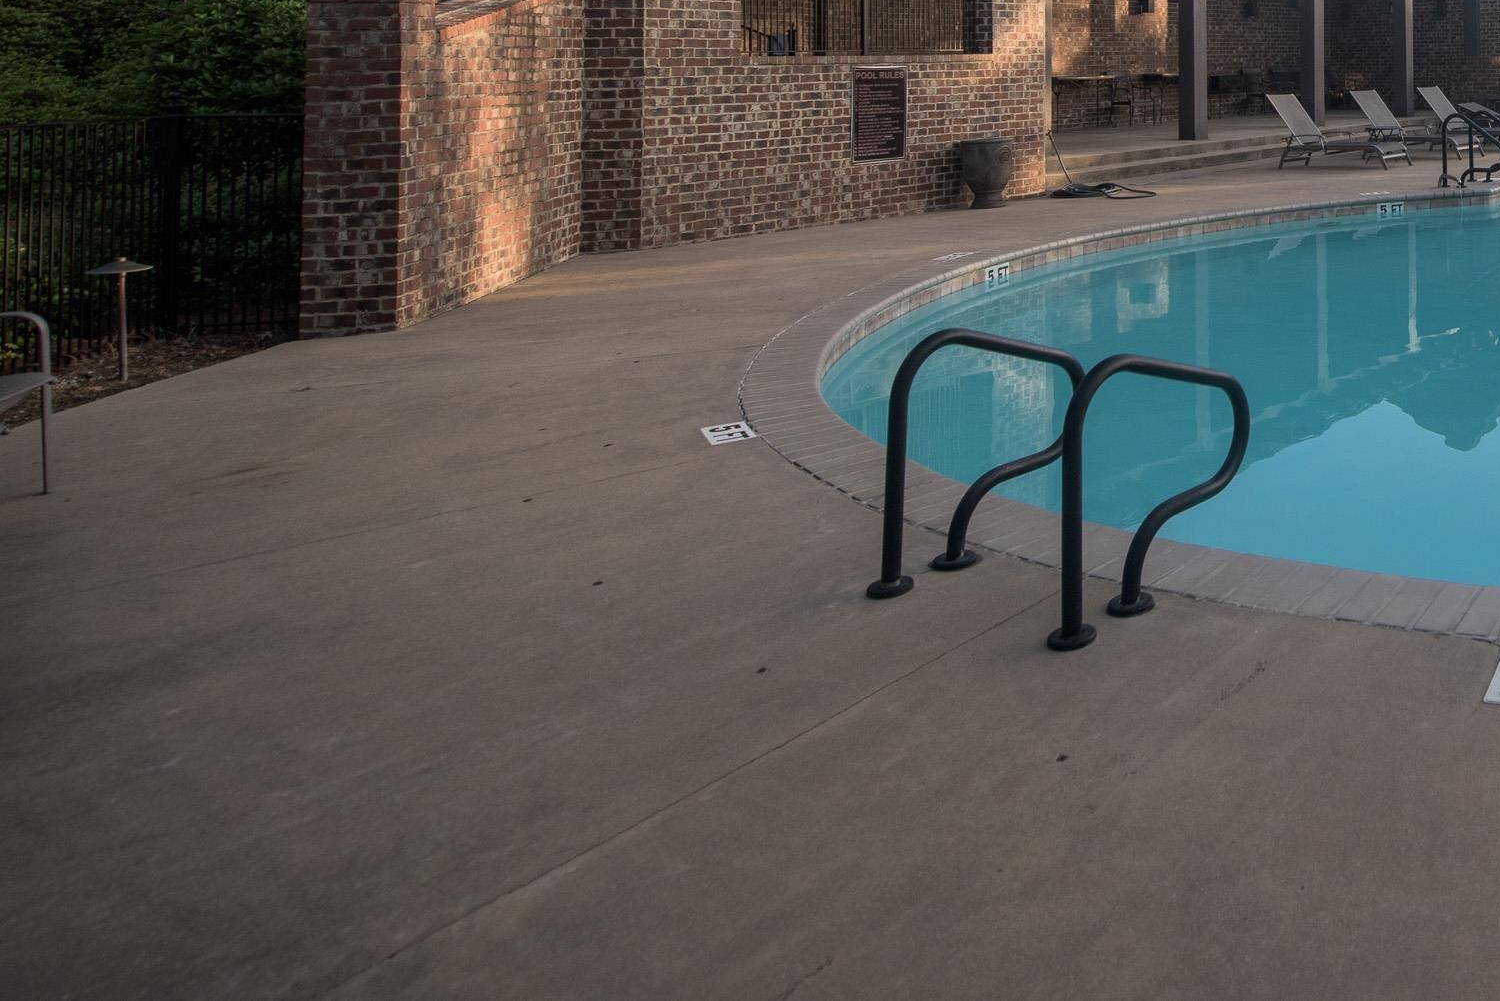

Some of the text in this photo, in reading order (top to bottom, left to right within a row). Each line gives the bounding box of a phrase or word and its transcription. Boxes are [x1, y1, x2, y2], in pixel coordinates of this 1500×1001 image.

[855, 71, 904, 80] POOL RULES
[988, 269, 994, 280] 5
[708, 424, 750, 442] 5 FT
